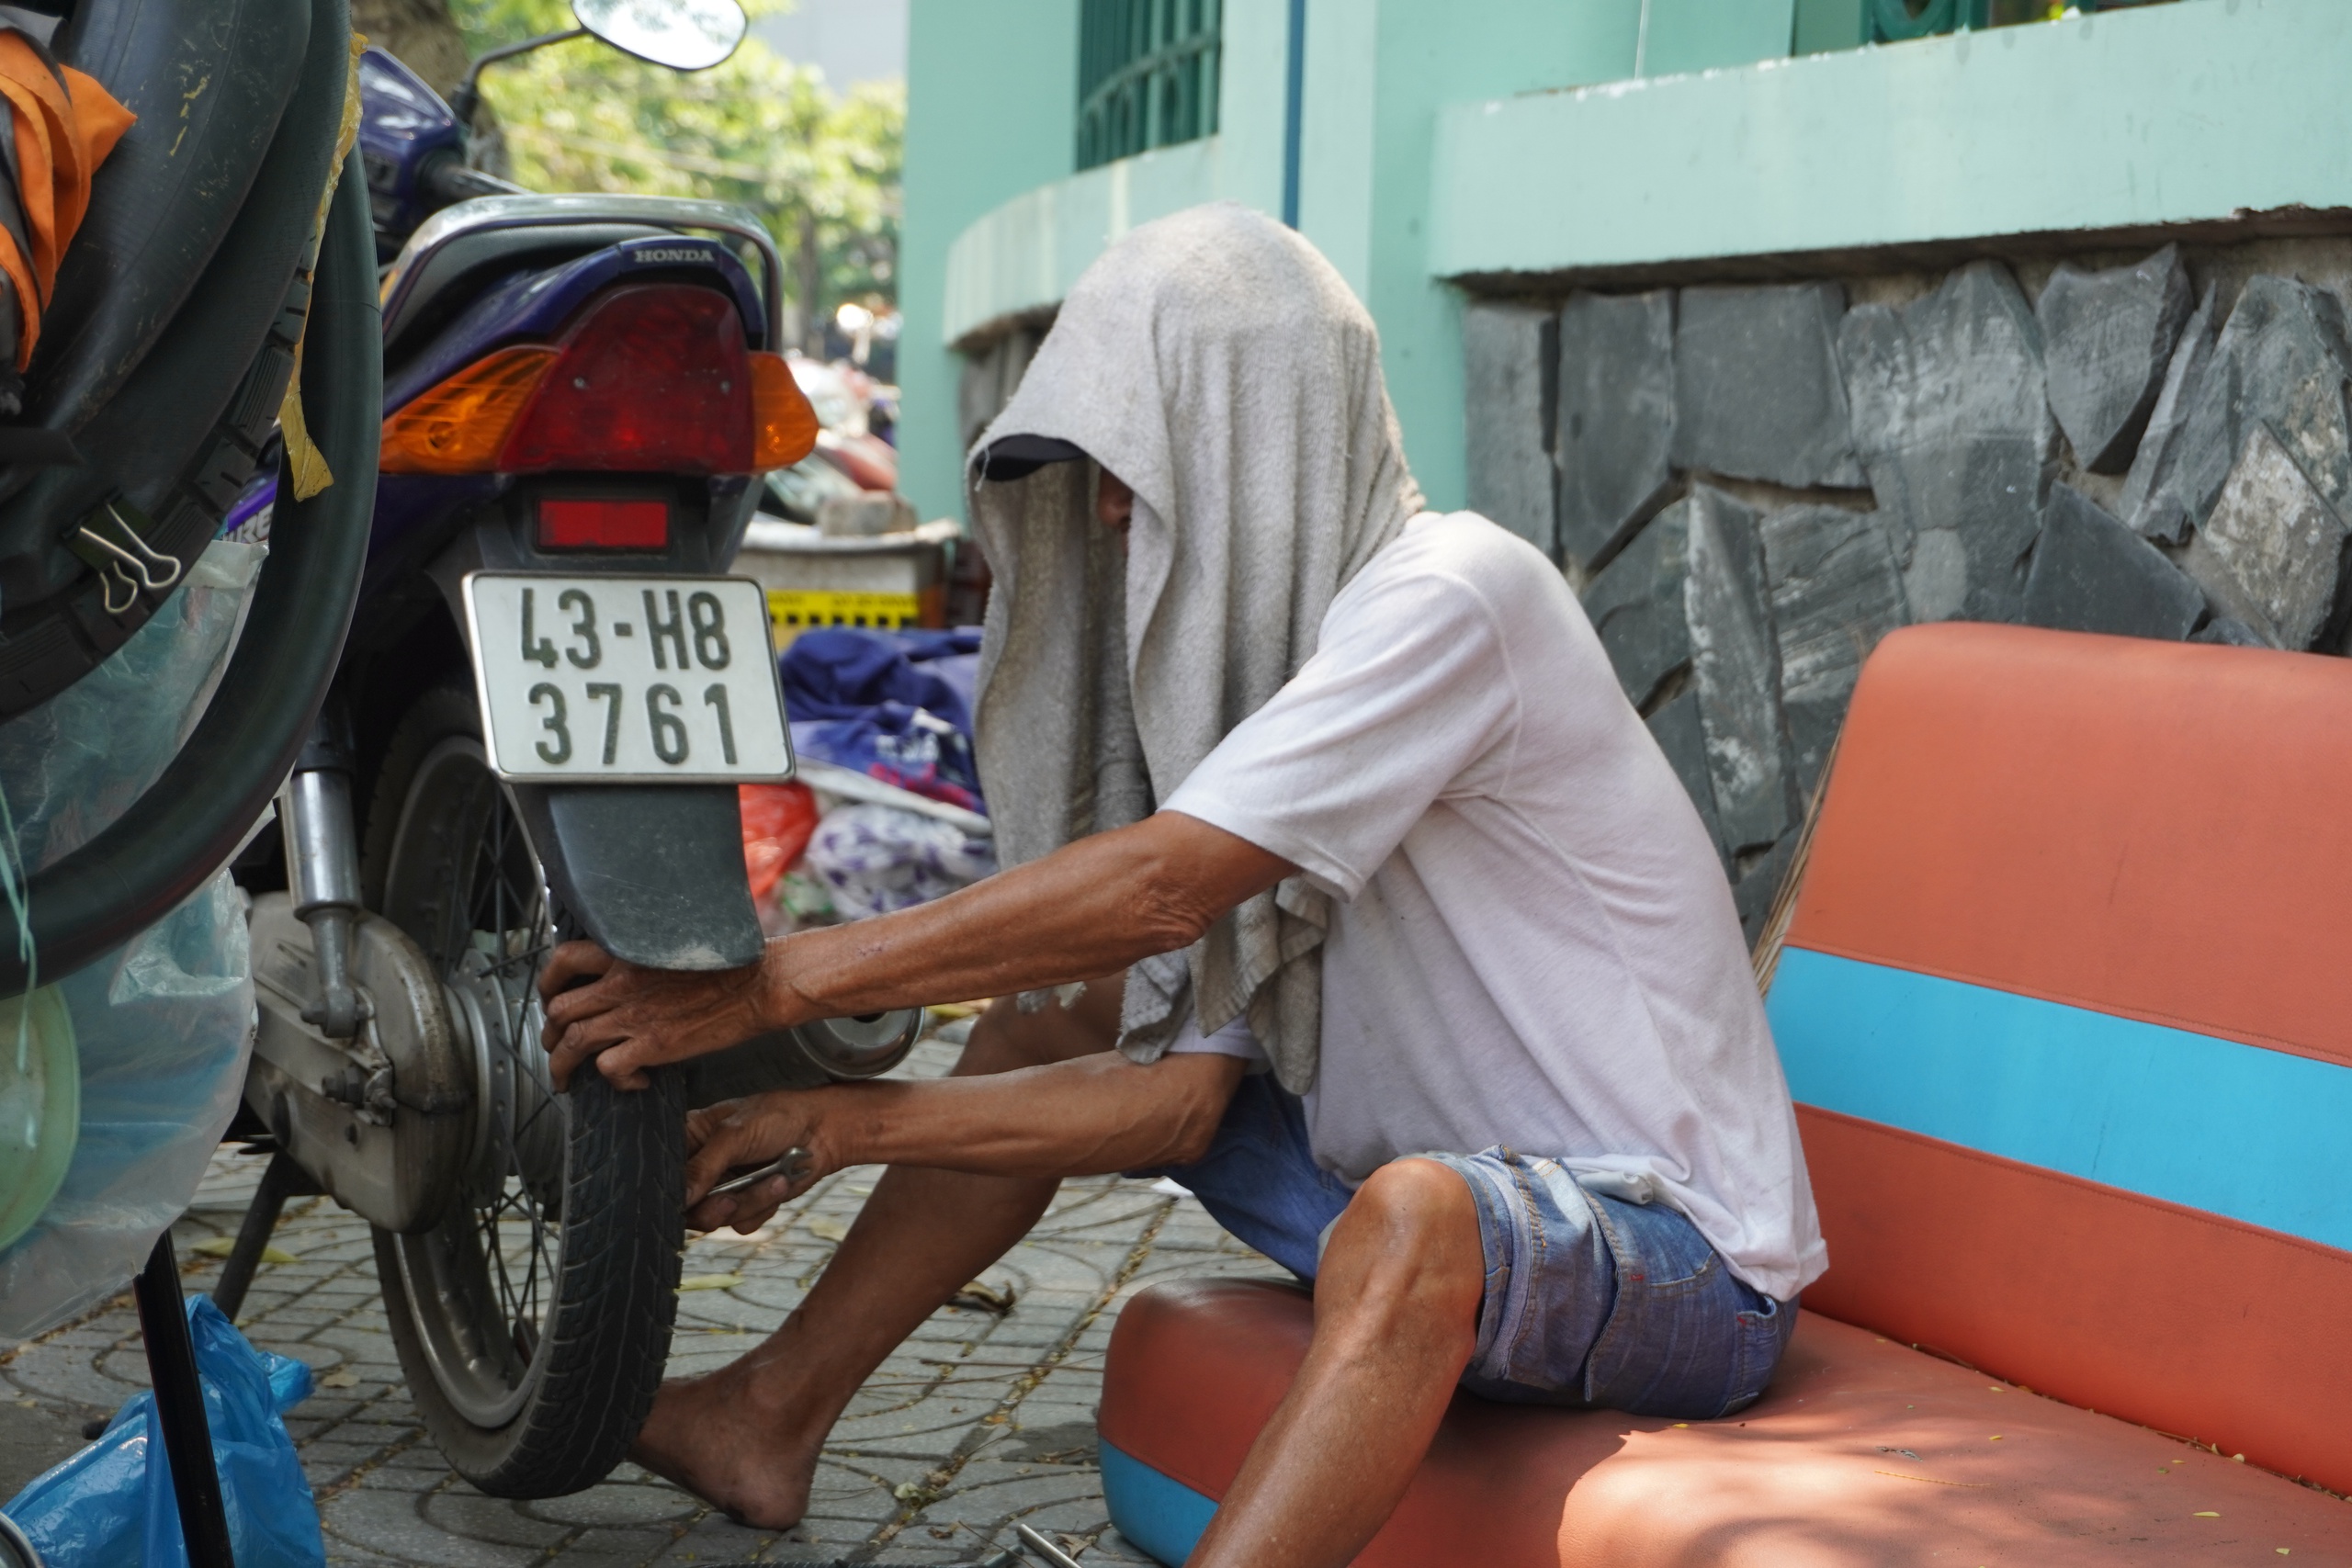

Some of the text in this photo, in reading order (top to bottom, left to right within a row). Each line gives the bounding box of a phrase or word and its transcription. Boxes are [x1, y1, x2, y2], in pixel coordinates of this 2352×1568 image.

[634, 248, 715, 263] HONDA
[521, 588, 730, 671] 43-H8
[528, 682, 737, 765] 3761
